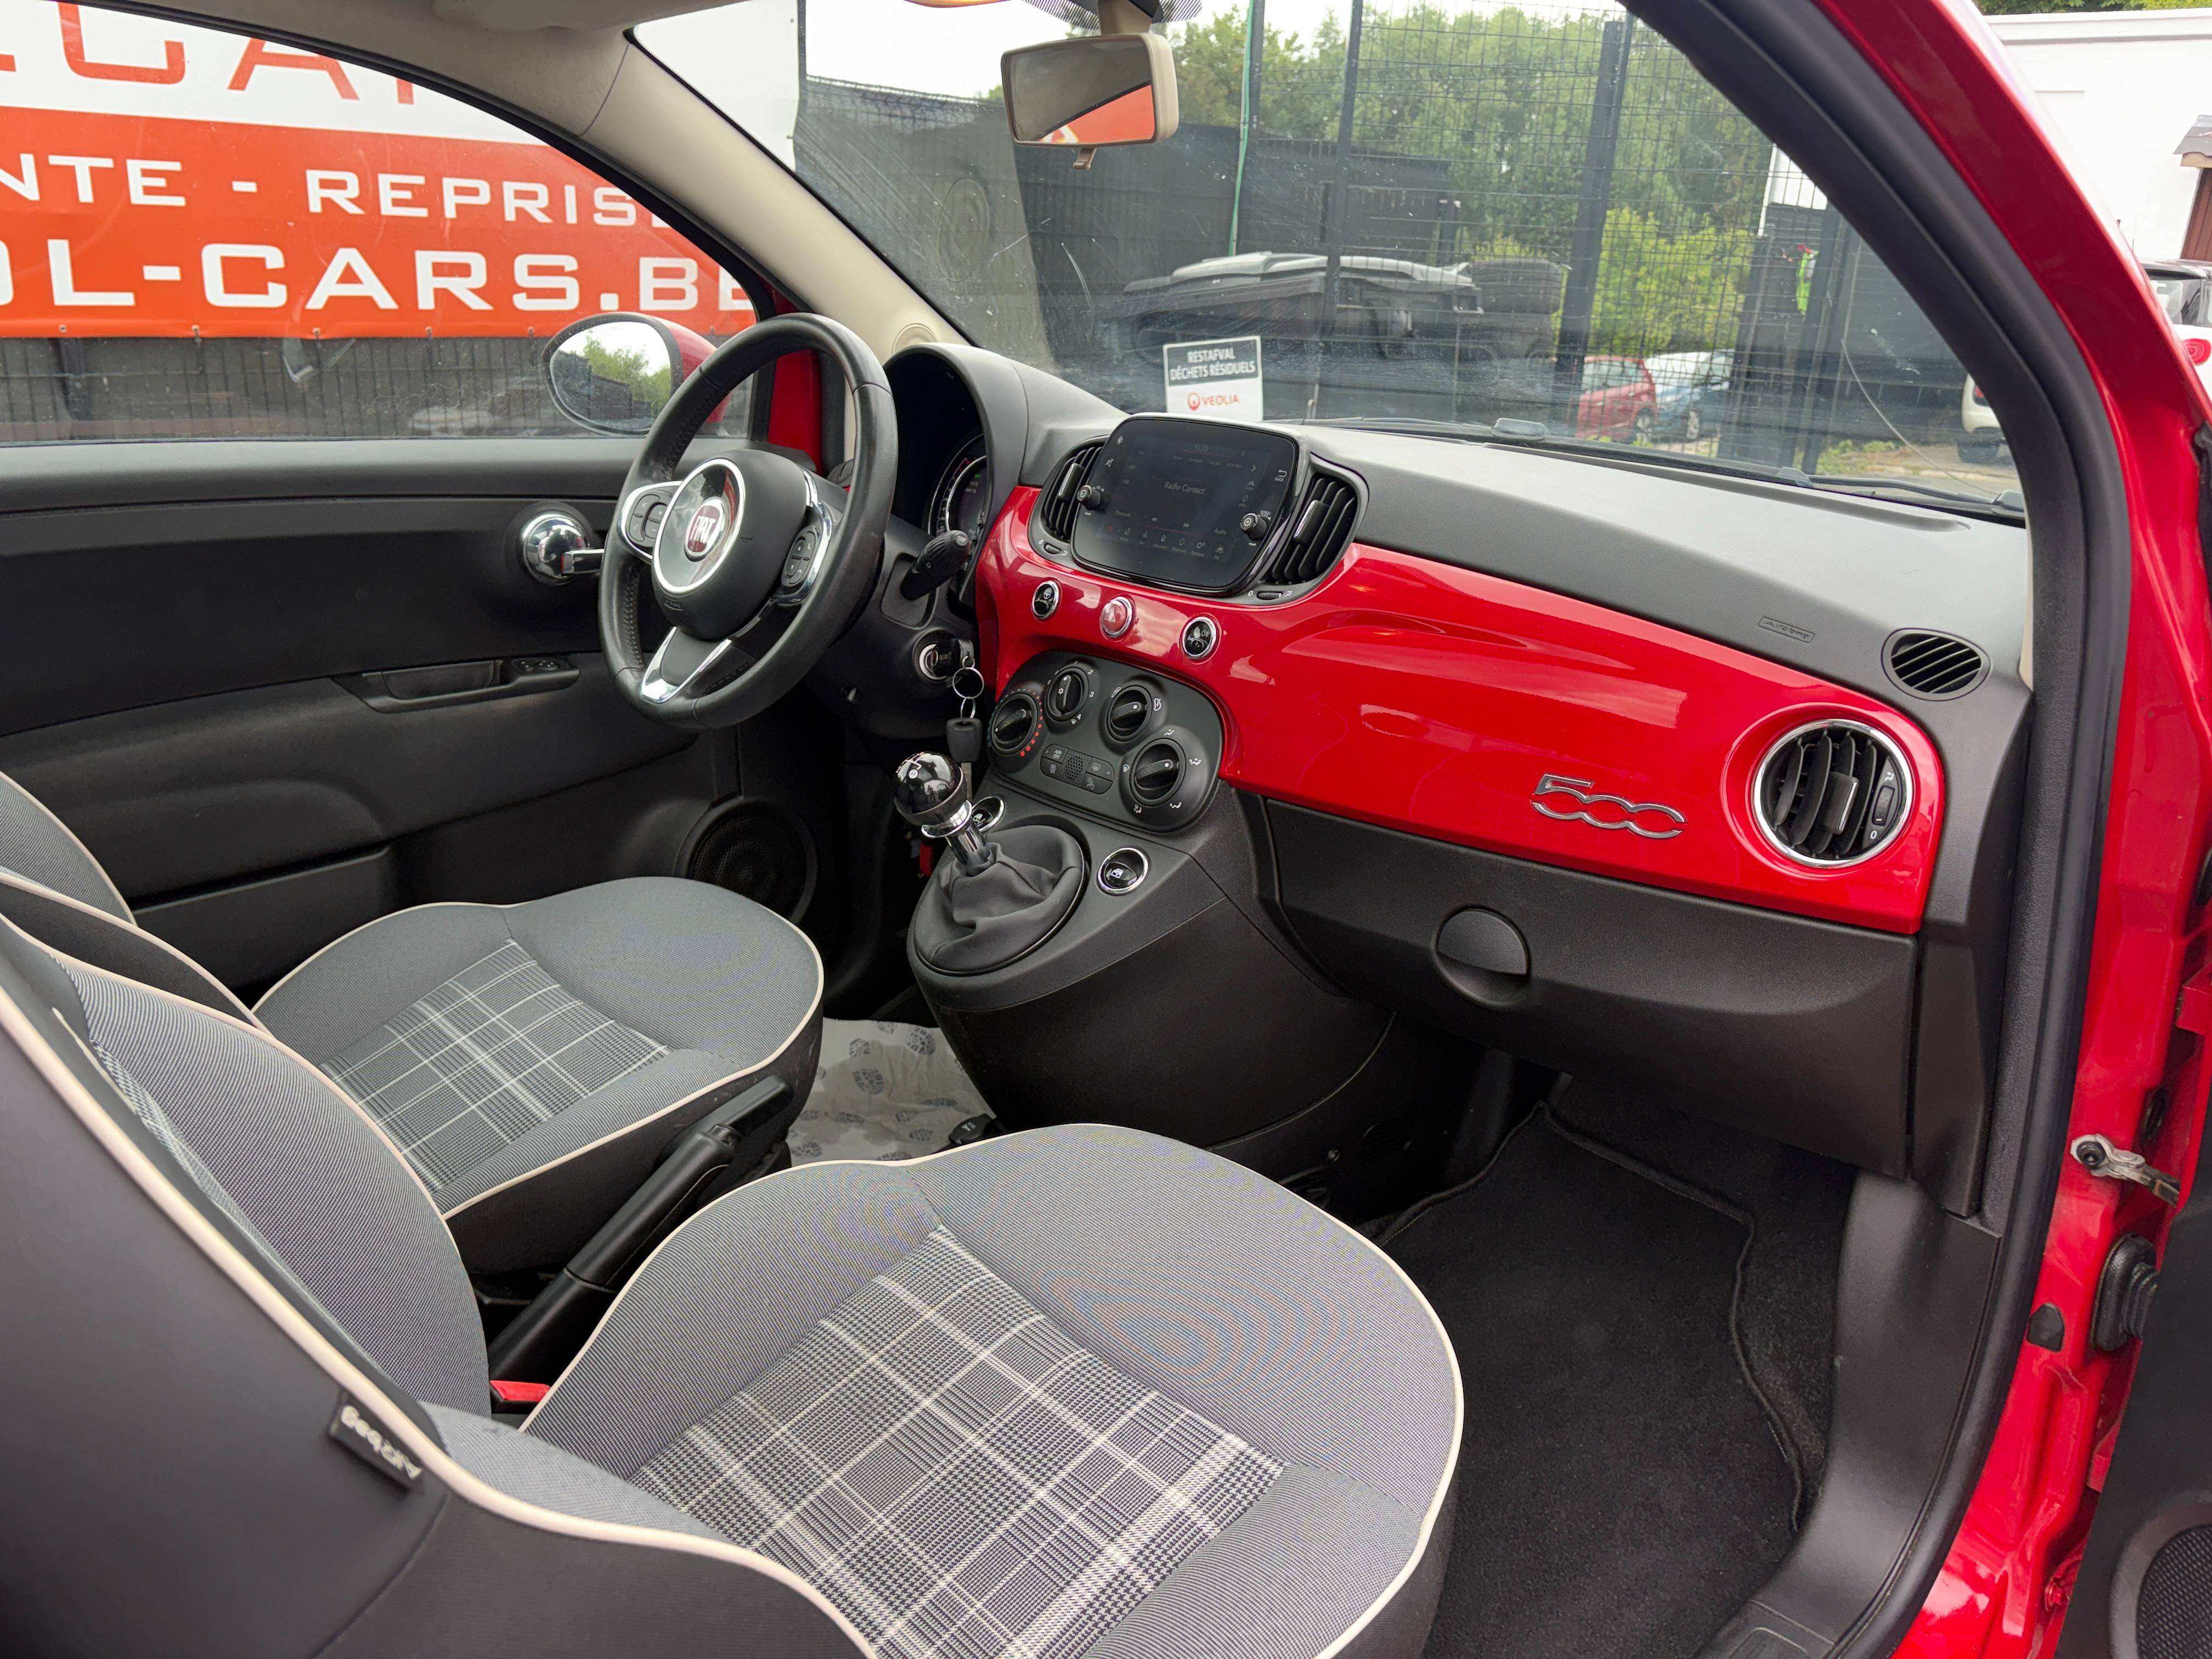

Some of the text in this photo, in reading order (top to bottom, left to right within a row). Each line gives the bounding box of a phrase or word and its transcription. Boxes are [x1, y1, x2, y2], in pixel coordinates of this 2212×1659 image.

[1169, 360, 1256, 381] DÉCHETS RÉSIDUELS
[1202, 394, 1240, 406] VEOLIA
[1164, 481, 1206, 495] Radio Contact
[690, 515, 716, 544] FIAT
[1531, 773, 1688, 839] 500
